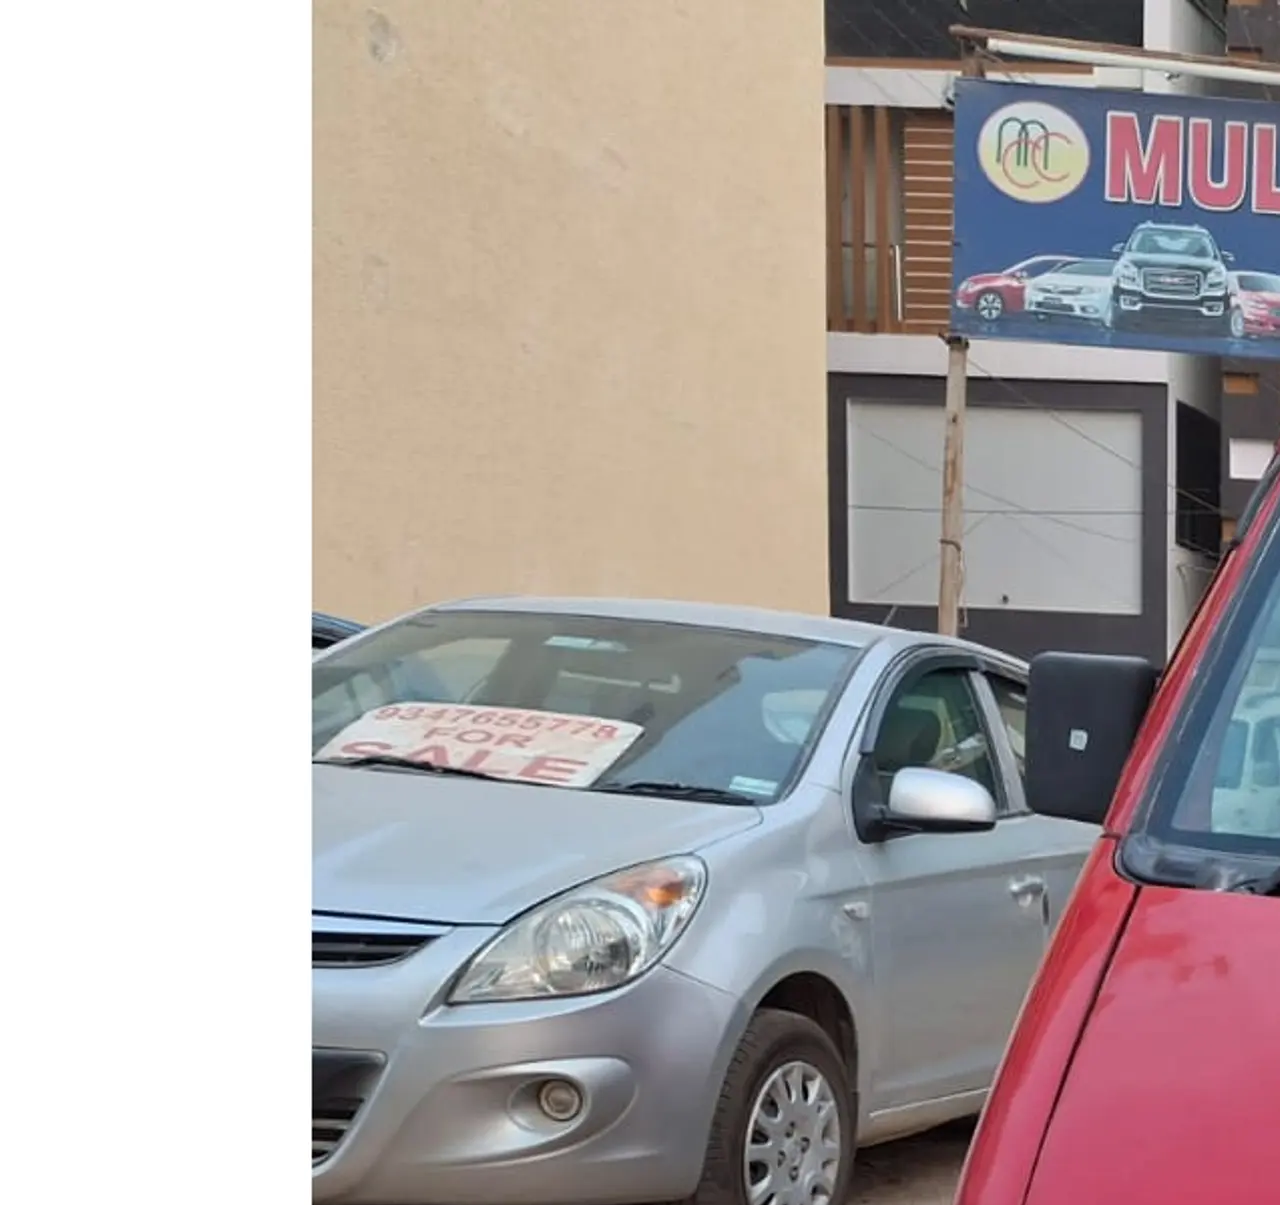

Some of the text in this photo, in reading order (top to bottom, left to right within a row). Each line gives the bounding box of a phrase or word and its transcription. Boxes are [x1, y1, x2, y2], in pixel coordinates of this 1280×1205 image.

[375, 705, 619, 739] 9347655778
[423, 727, 534, 749] FOR
[341, 741, 588, 782] SALE
